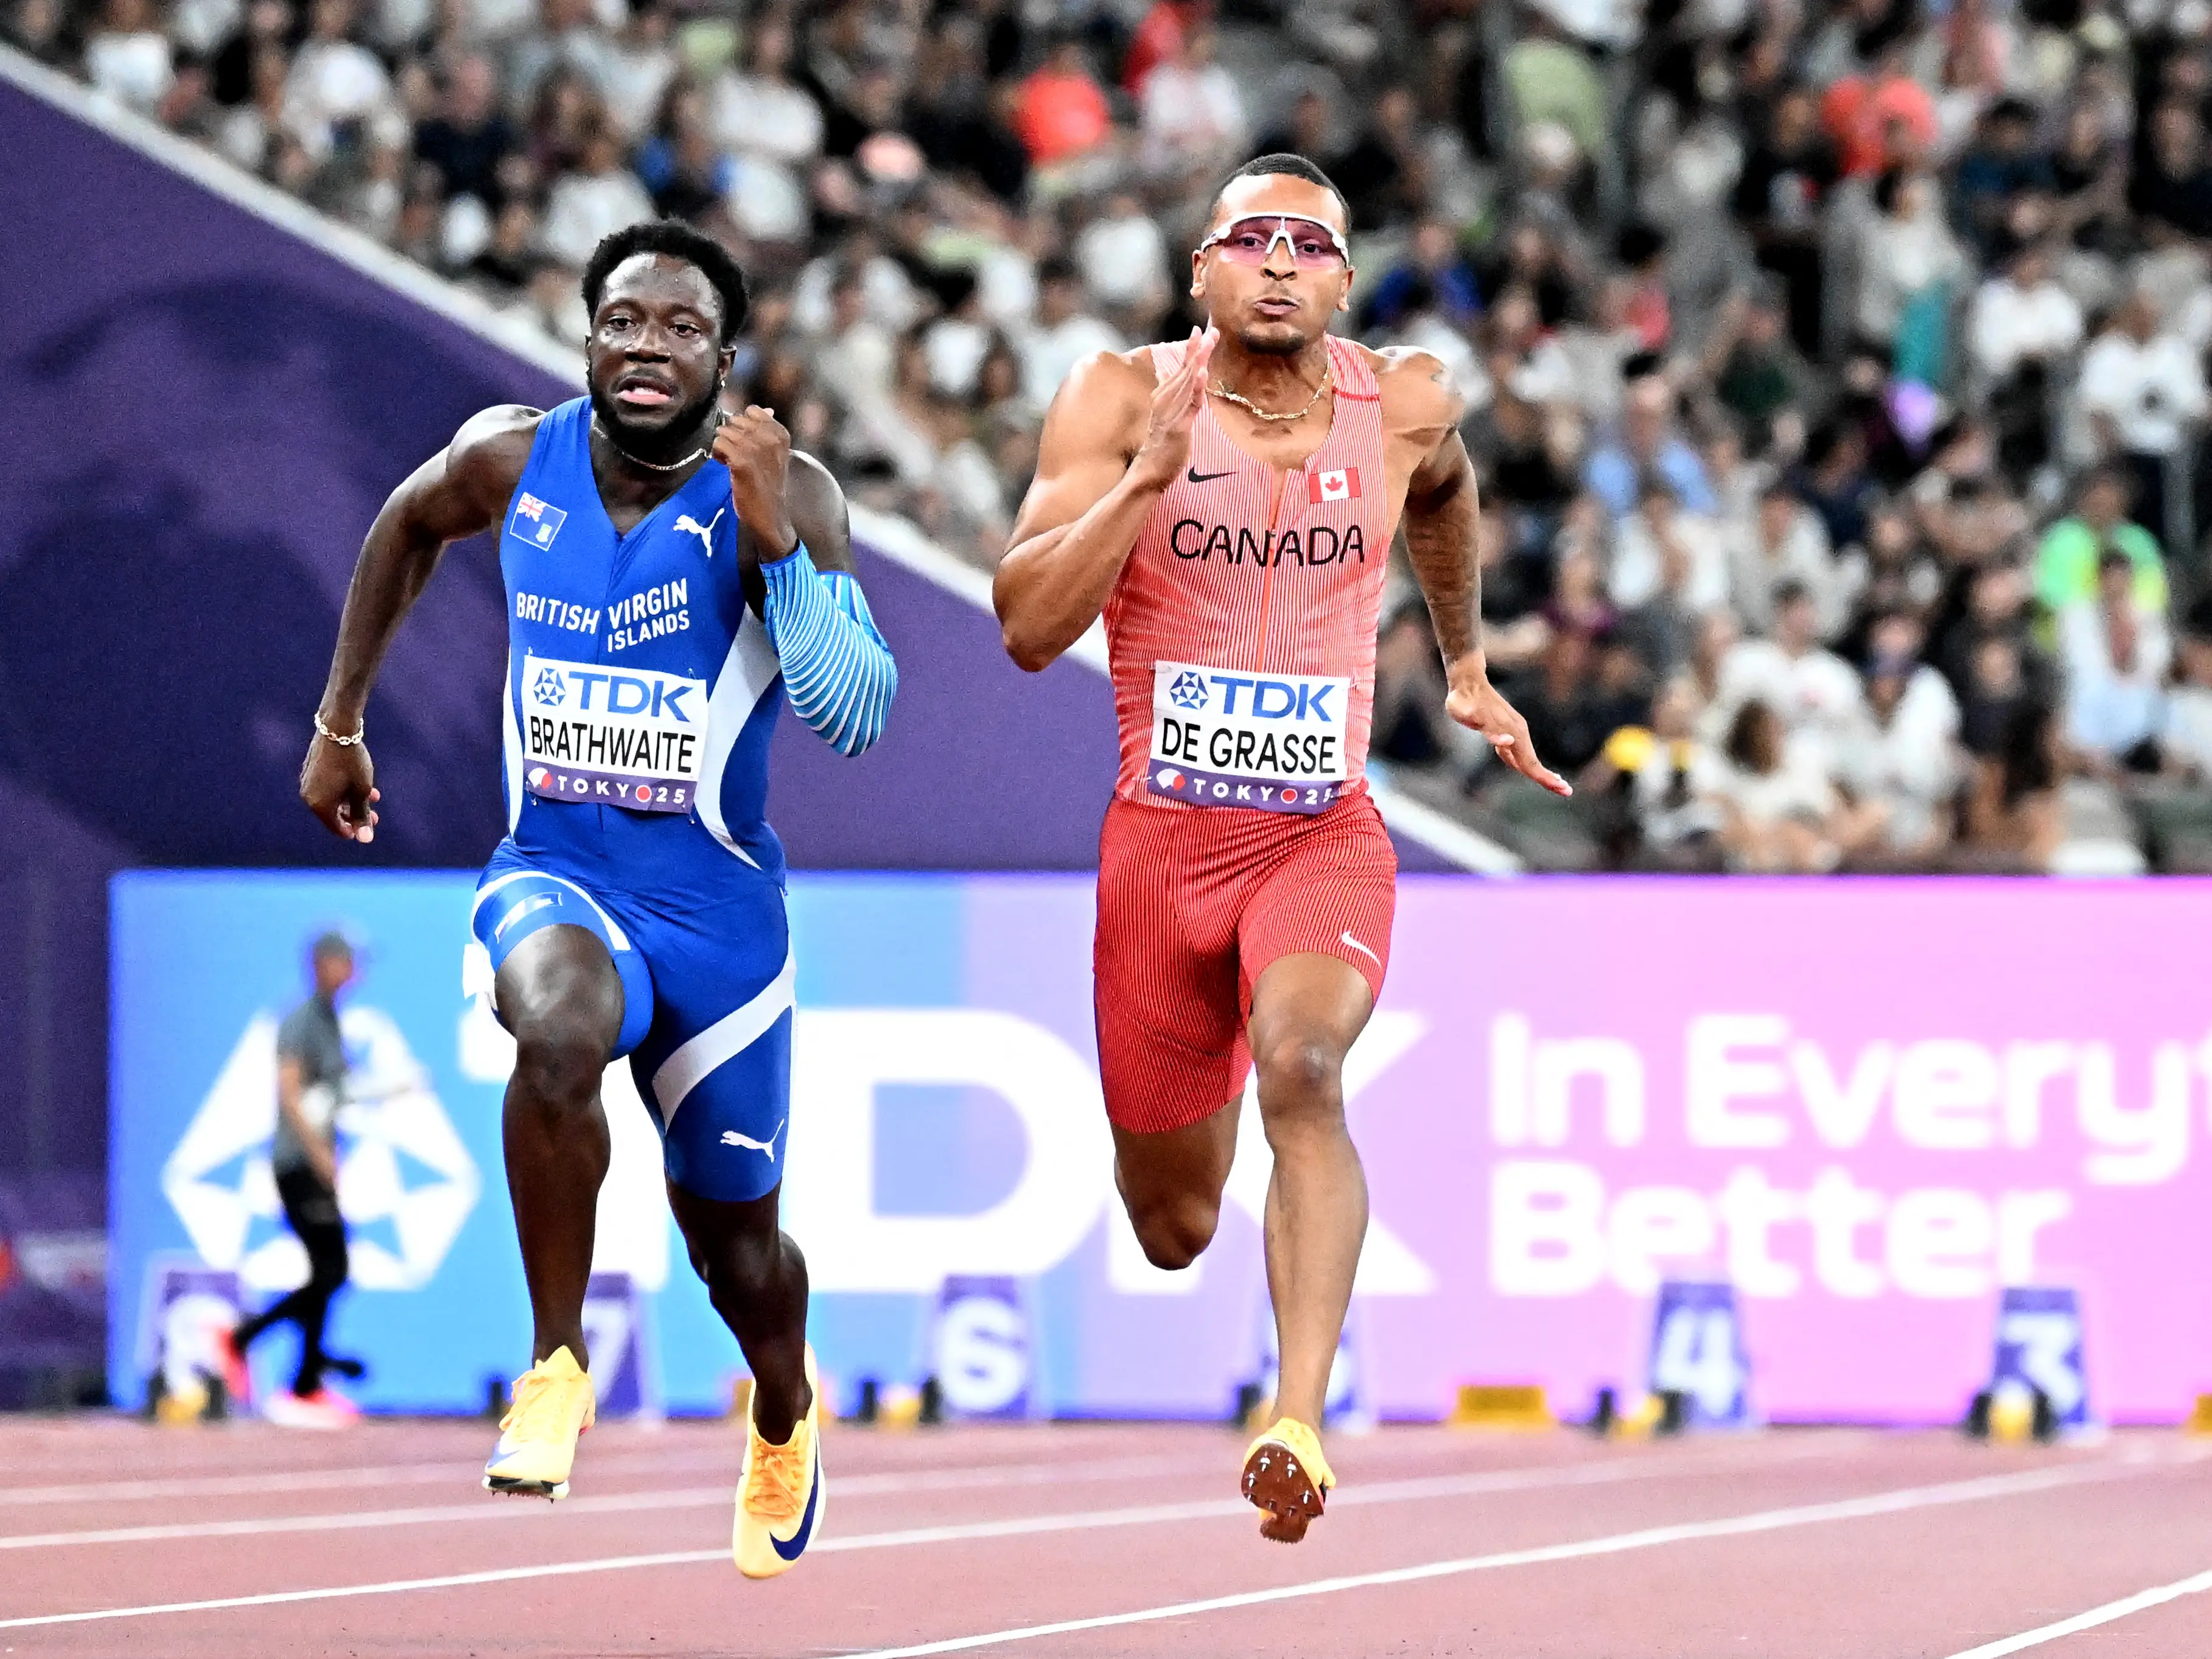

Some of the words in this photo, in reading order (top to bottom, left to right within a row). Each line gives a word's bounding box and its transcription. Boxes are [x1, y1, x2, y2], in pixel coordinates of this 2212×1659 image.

[1171, 519, 1365, 567] CANADA
[516, 592, 600, 635] BRITISH
[608, 578, 688, 629] VIRGIN
[607, 610, 690, 652] ISLANDS
[568, 671, 693, 723] TDK
[1210, 675, 1335, 722] TDK
[530, 716, 696, 773] BRATHWAITE
[1161, 718, 1202, 761] DE
[1209, 728, 1336, 774] GRASSE
[1489, 1009, 1646, 1150] In
[1684, 1011, 2212, 1186] Every
[1489, 1156, 2073, 1299] Better
[1653, 1306, 1742, 1414] 4
[2001, 1312, 2077, 1412] 3
